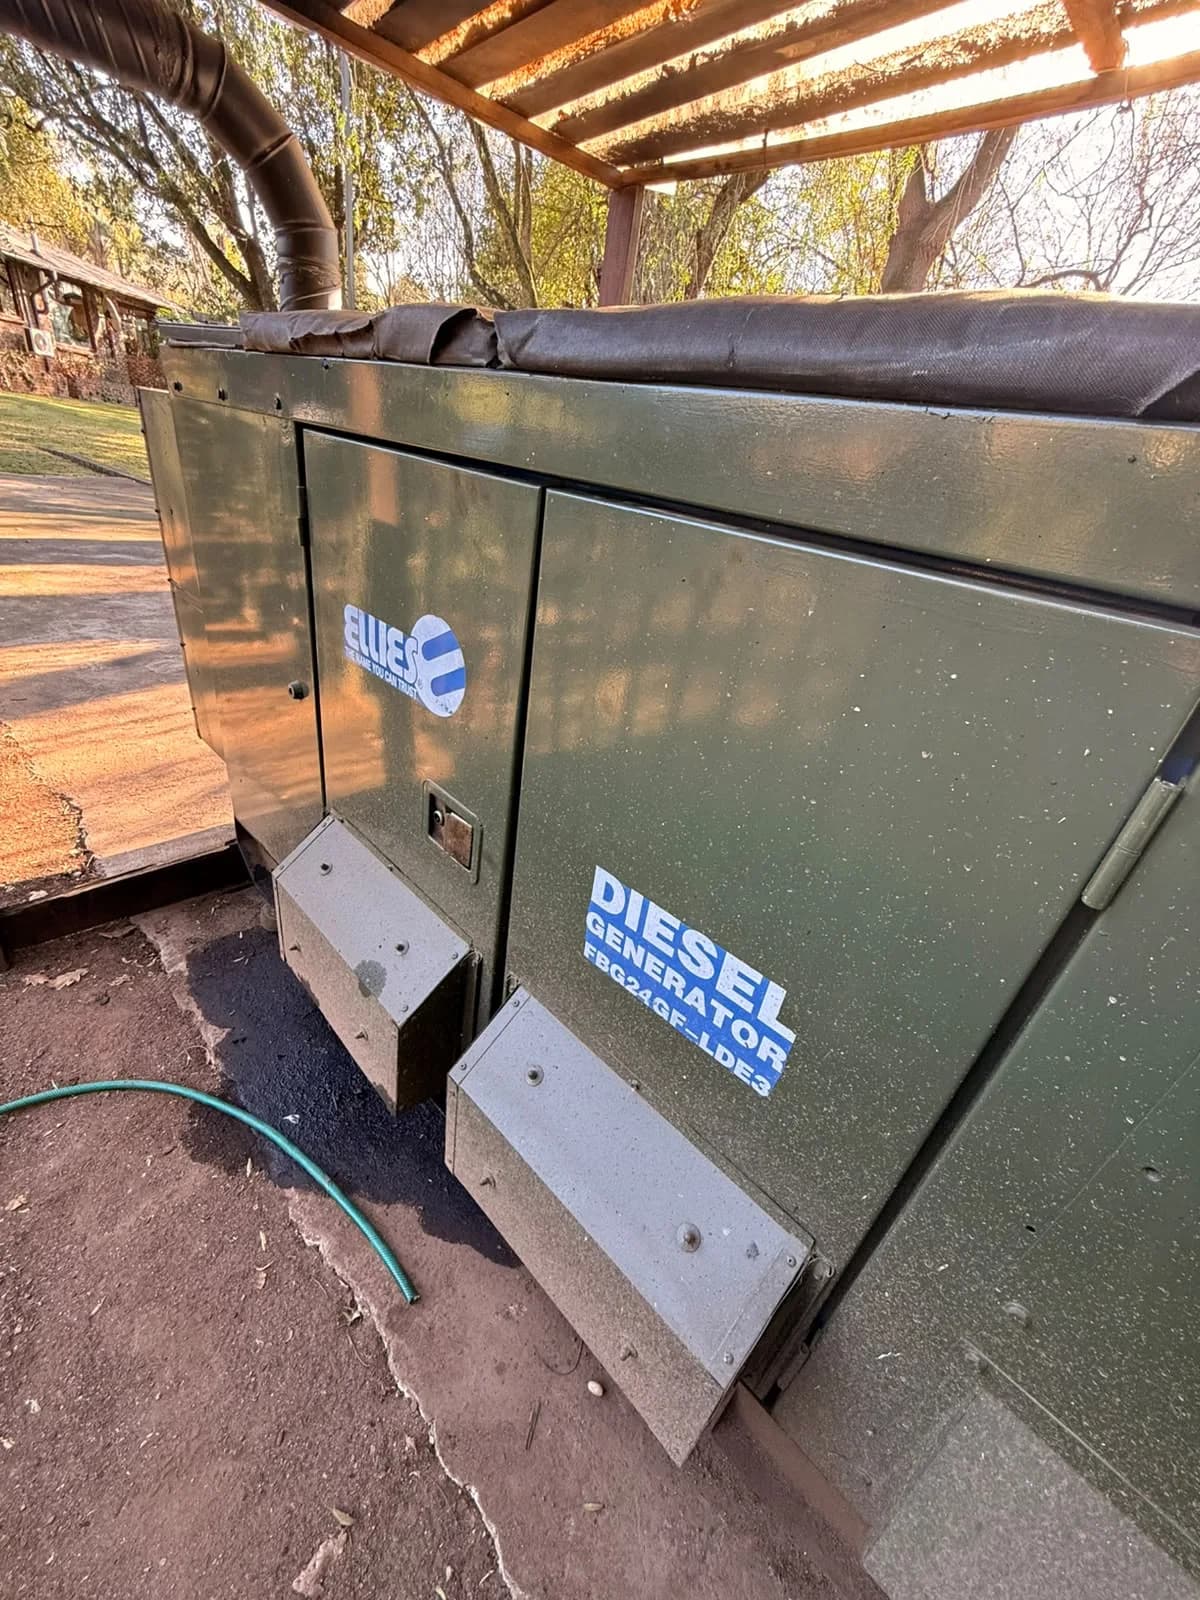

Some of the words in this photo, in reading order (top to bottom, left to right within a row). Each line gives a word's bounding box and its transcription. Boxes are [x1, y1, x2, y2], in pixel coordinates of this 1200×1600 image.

[343, 603, 419, 684] ELLIES
[398, 680, 417, 700] TRUST
[585, 911, 788, 1074] GENERATOR
[590, 864, 797, 1044] DIESEL
